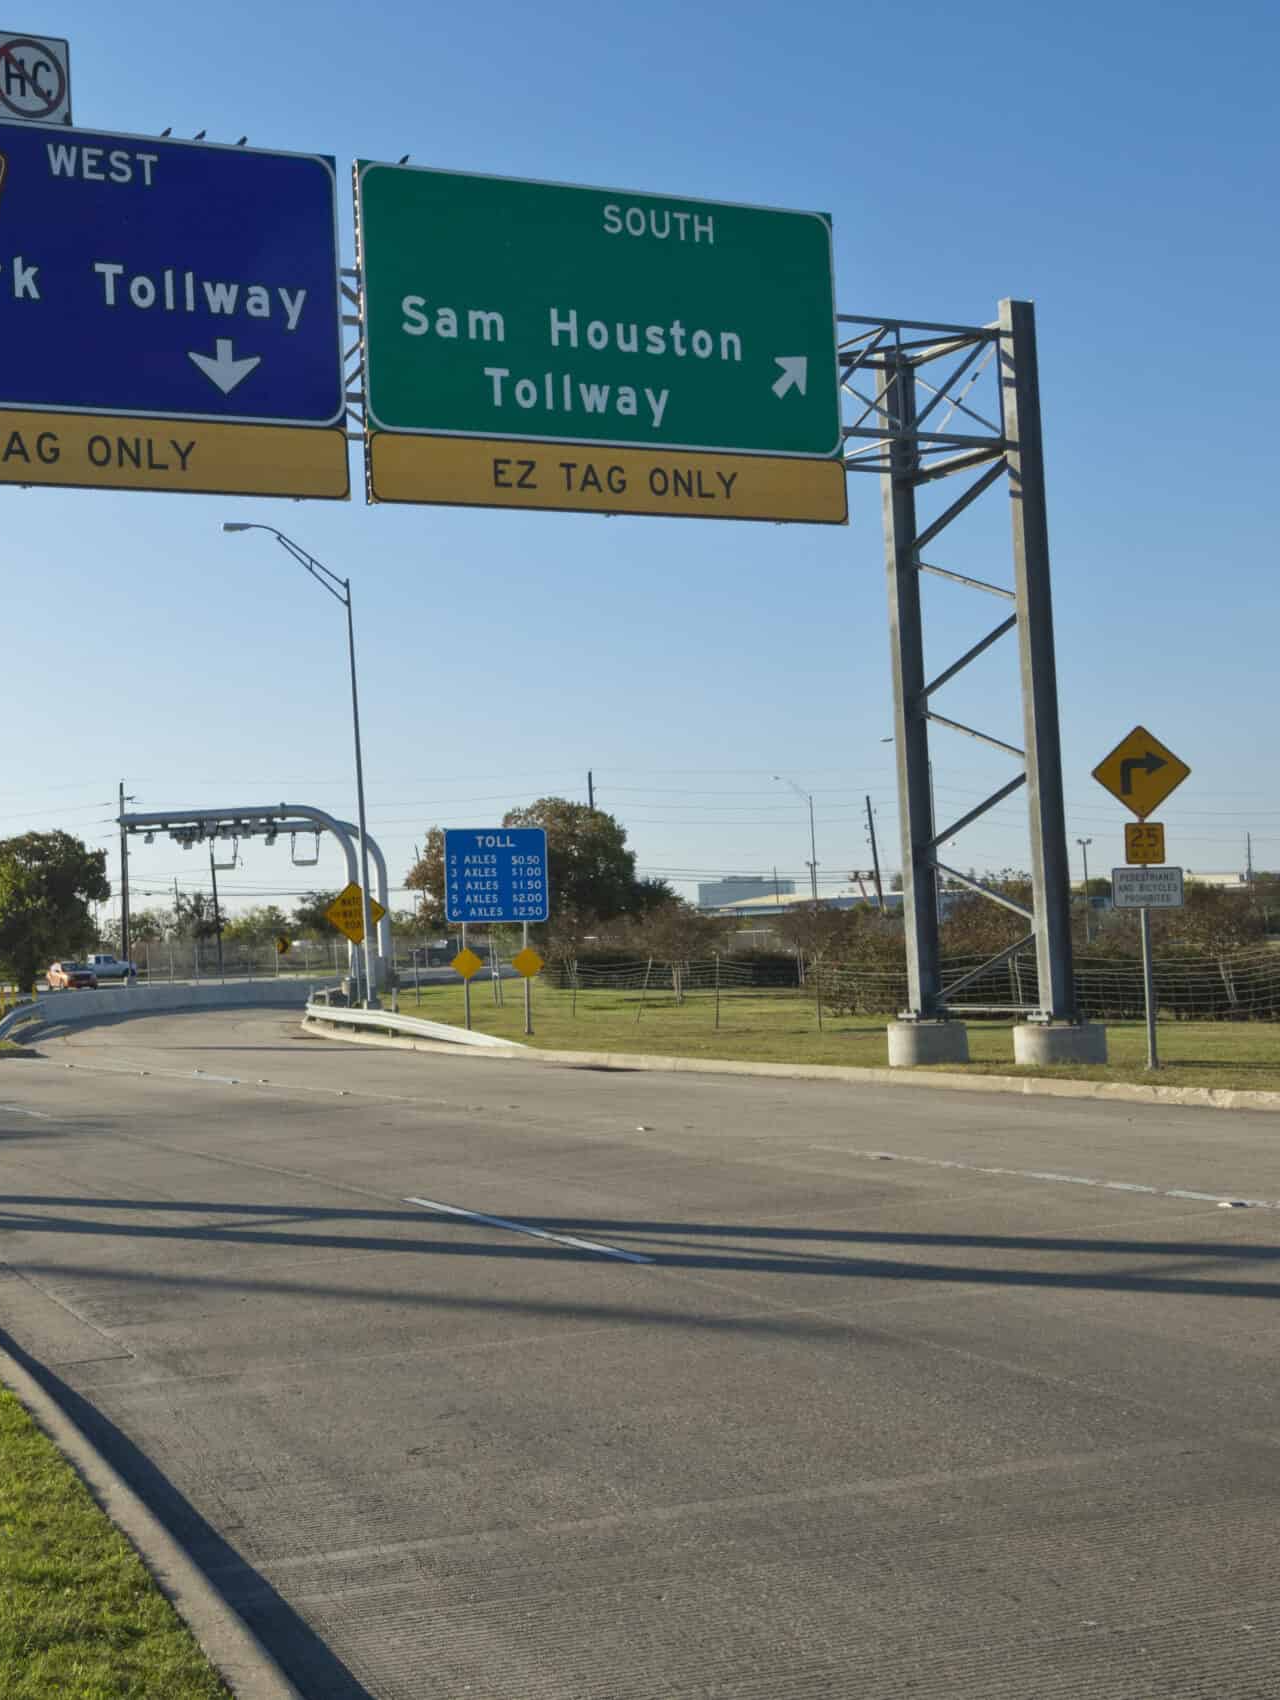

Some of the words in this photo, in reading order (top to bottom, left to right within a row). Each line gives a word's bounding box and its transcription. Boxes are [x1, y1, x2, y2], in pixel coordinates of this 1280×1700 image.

[46, 142, 159, 187] WEST
[602, 203, 716, 245] SOUTH
[94, 262, 308, 331] Tollway
[401, 295, 506, 342] Sam
[549, 307, 742, 361] Houston
[483, 366, 670, 428] Tollway
[86, 434, 197, 471] ONLY
[492, 458, 538, 490] EZ
[558, 461, 627, 495] TAG
[648, 467, 738, 500] ONLY
[475, 835, 516, 849] TOLL
[1130, 826, 1159, 848] 25
[450, 855, 458, 865] 2
[463, 854, 497, 865] AXLES
[451, 867, 458, 878] 3
[463, 867, 497, 878] AXLES
[450, 881, 459, 891] 4
[465, 880, 498, 891] AXLES
[451, 893, 459, 904] 5
[465, 893, 499, 904] AXLES
[469, 906, 504, 917] AXLES
